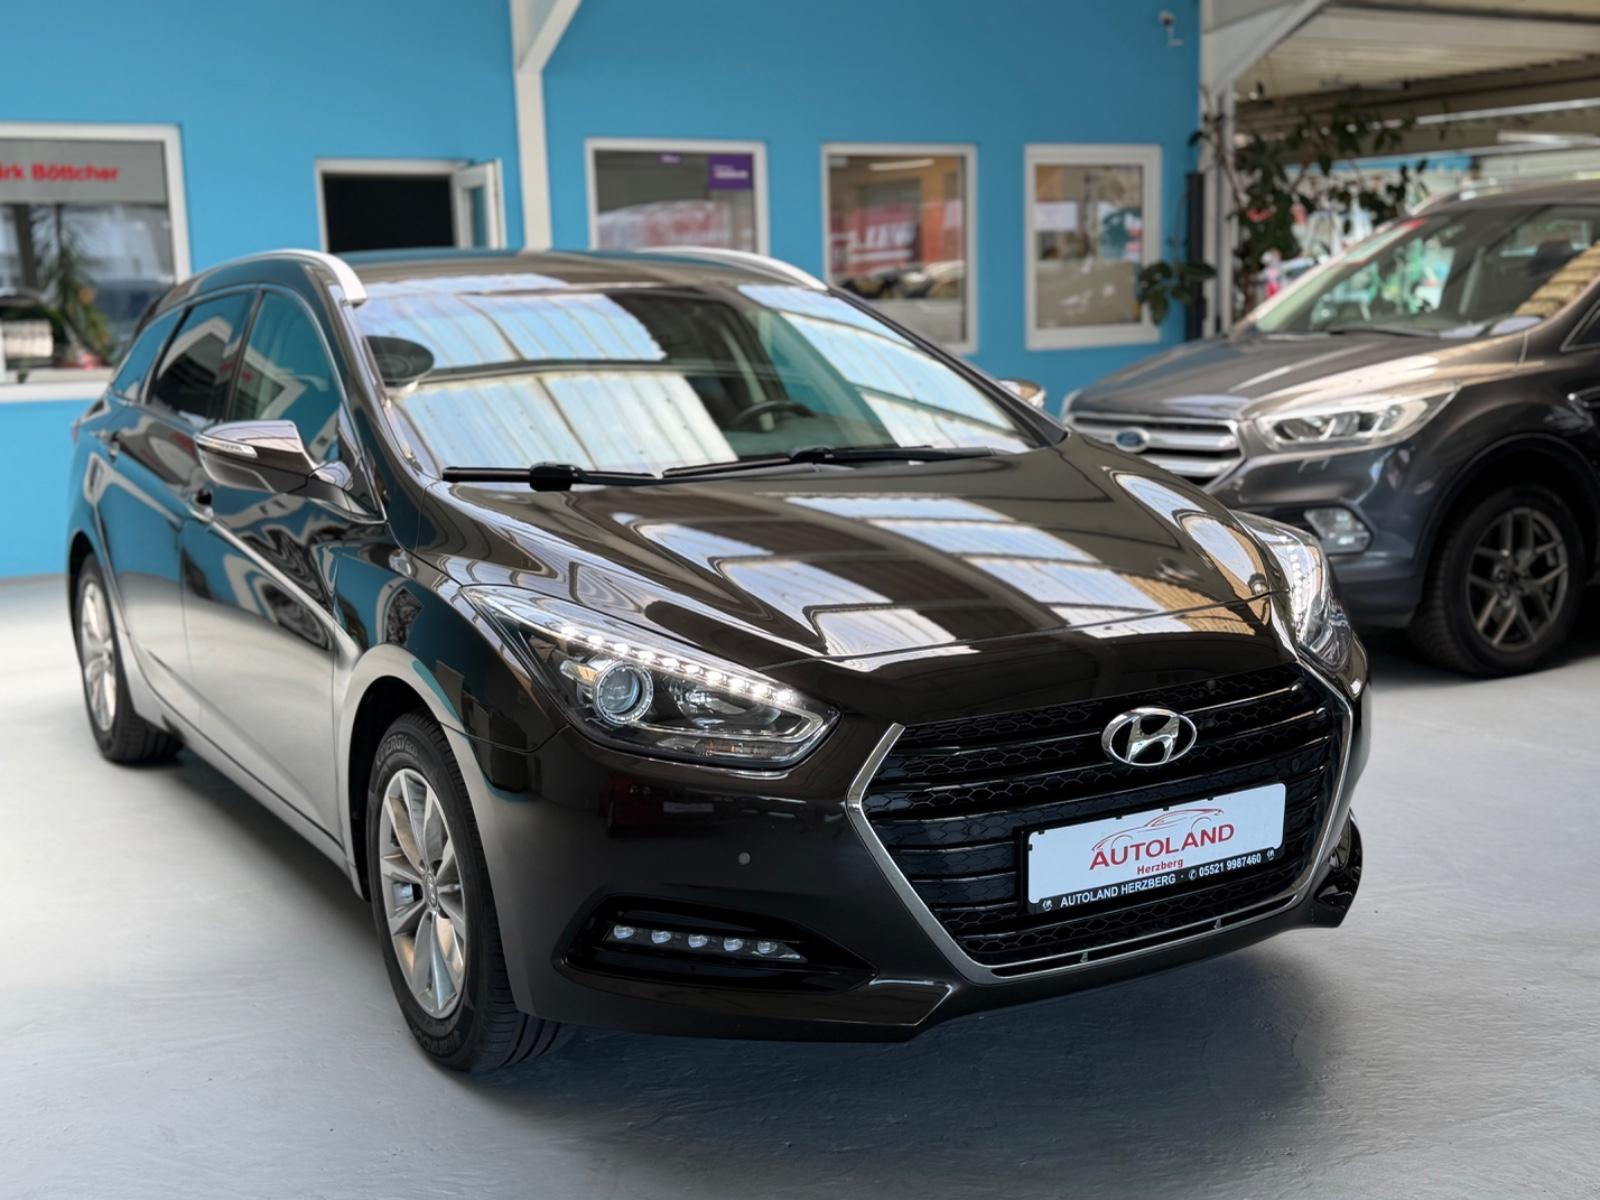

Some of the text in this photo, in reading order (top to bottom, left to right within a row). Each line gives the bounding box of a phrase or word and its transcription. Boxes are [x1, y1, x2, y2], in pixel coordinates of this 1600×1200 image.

[31, 162, 119, 181] Böttcher
[1089, 823, 1234, 870] AUTOLAND
[1060, 853, 1262, 908] AUTOLAND HERZBERG 05521 9987460
[1136, 858, 1184, 875] Herzberg
